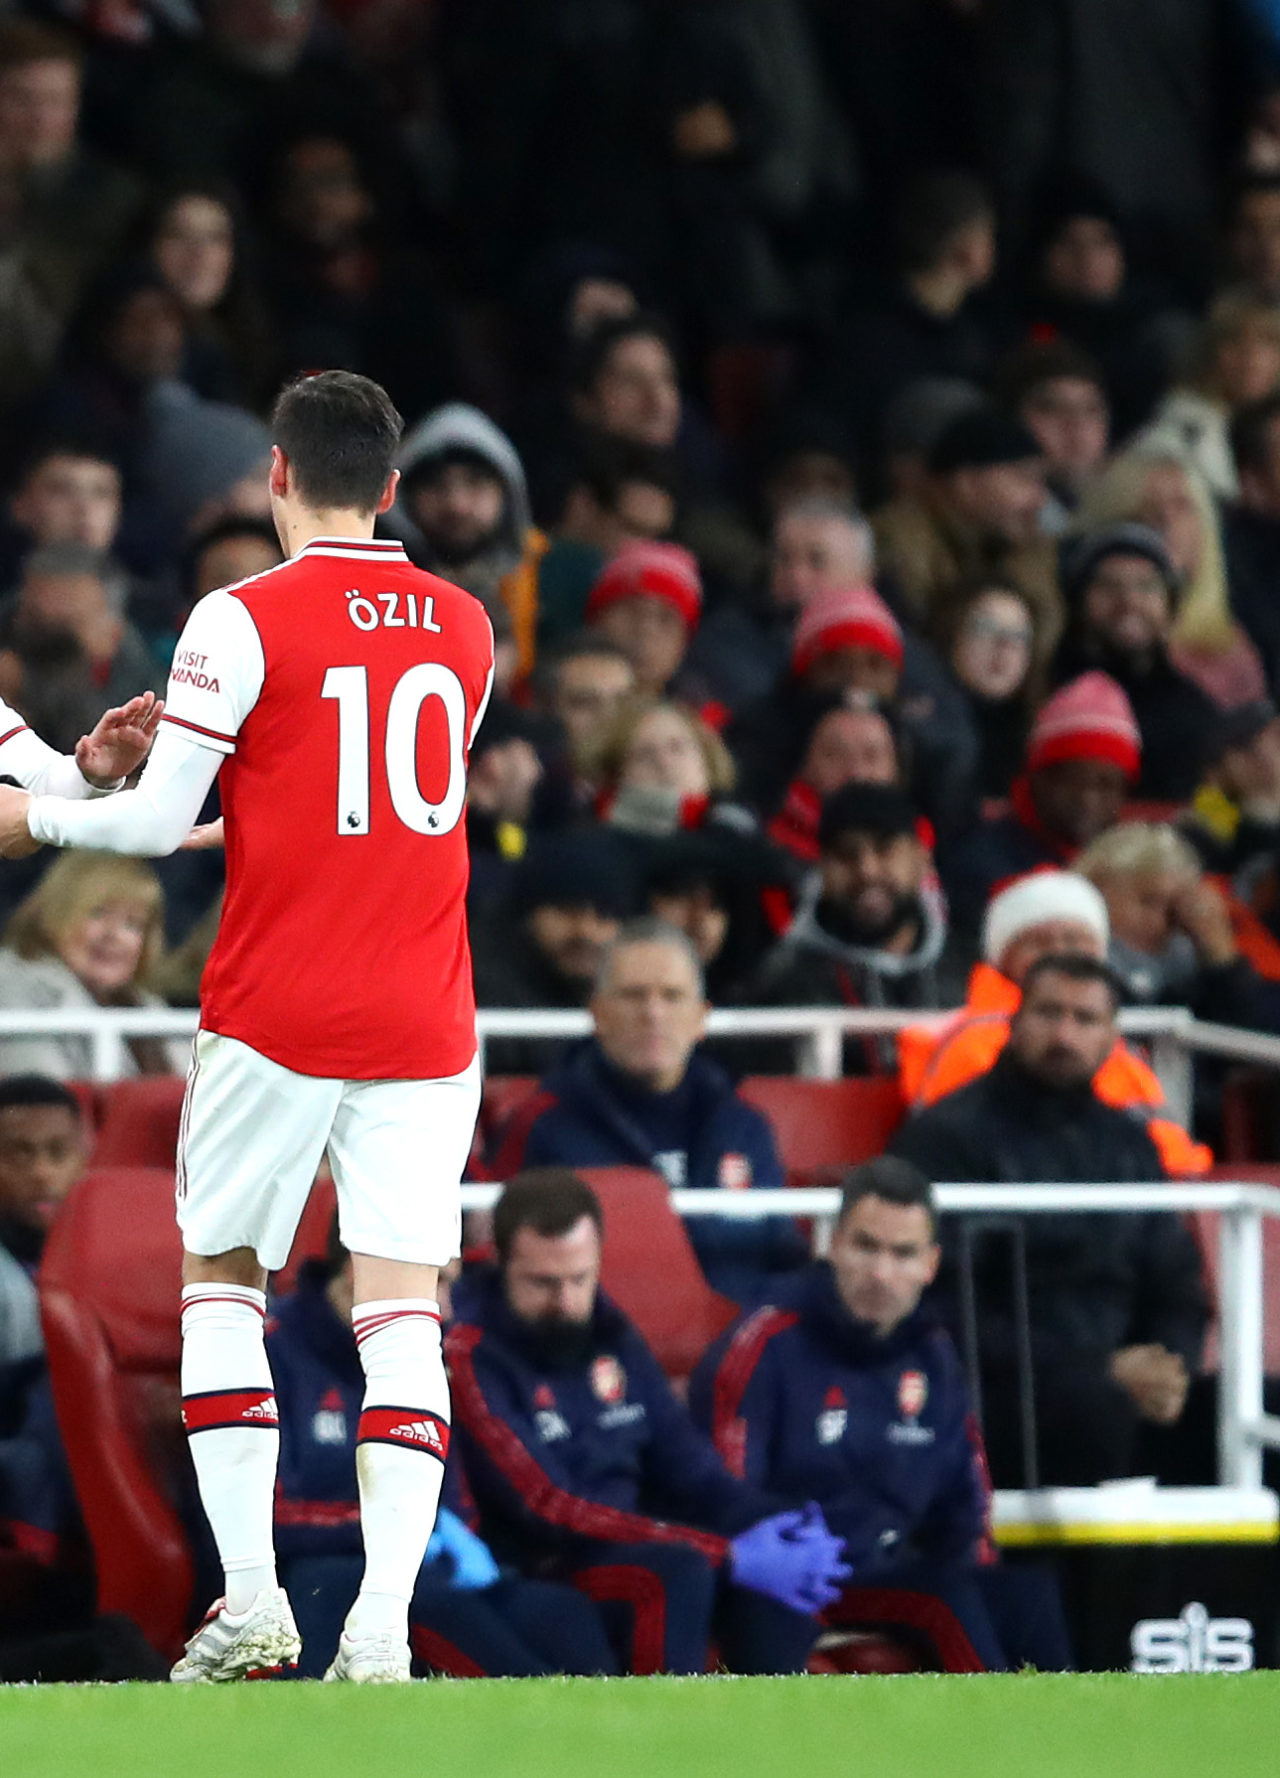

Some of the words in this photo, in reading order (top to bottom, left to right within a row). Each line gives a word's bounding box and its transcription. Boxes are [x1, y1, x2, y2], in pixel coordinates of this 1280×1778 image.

[344, 588, 443, 634] ÖZIL
[177, 649, 208, 669] VISIT
[320, 662, 467, 837] 10
[389, 1427, 443, 1451] adidas
